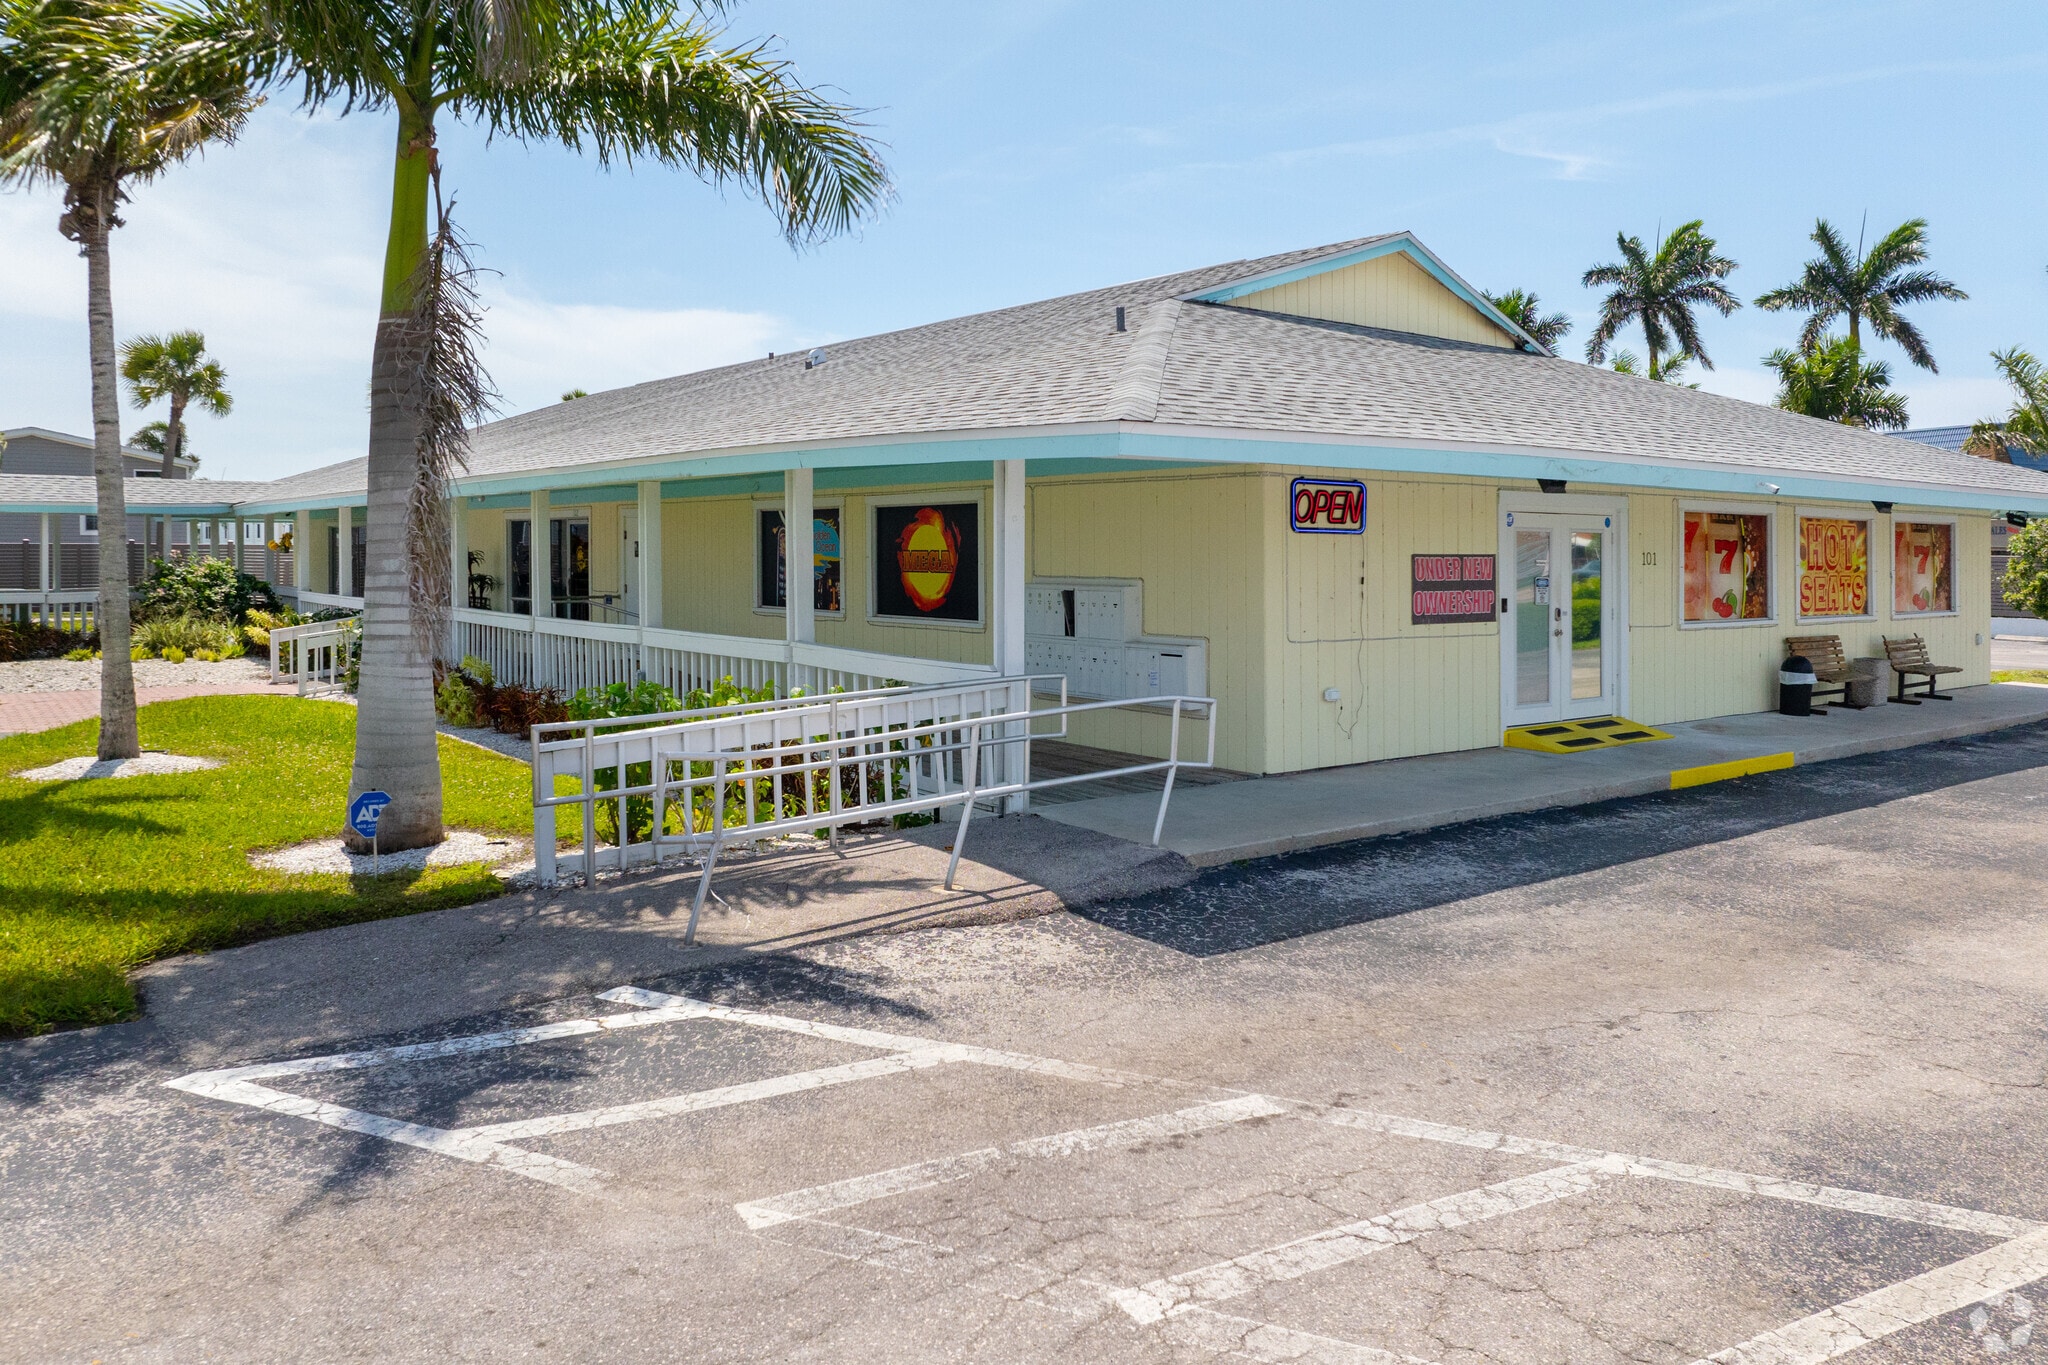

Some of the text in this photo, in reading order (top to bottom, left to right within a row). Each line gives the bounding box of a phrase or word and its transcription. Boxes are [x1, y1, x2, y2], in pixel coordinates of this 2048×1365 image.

[1295, 490, 1364, 523] OPEN
[1642, 551, 1657, 566] 101
[1714, 539, 1738, 574] 7
[1806, 523, 1857, 571] HOT
[1914, 545, 1930, 574] 7
[902, 550, 953, 574] MEGA
[1414, 556, 1493, 581] UNDER NEW
[1413, 589, 1495, 616] OWNERSHIP
[1800, 575, 1867, 614] SEATS
